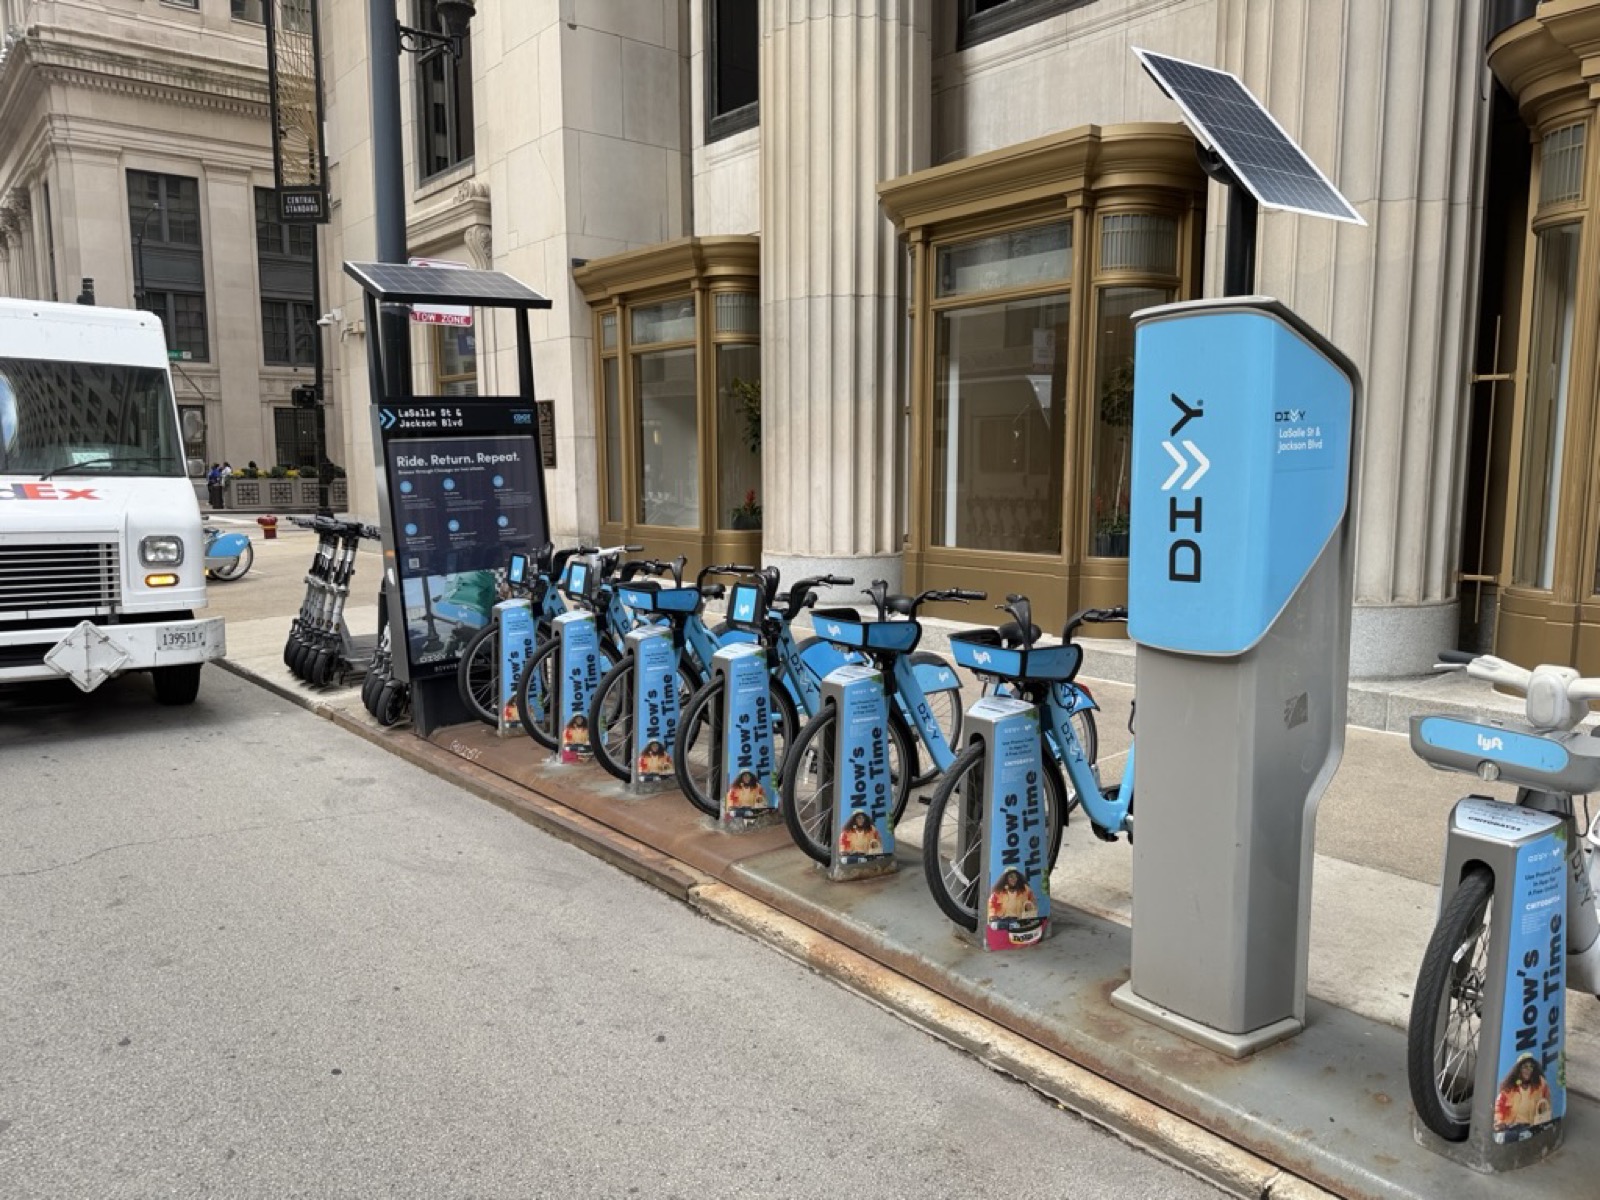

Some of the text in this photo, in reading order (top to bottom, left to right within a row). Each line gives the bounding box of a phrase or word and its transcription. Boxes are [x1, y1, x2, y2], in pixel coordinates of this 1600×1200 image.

[285, 205, 318, 213] STANDARD
[441, 316, 465, 325] ZONE
[397, 408, 462, 417] LaSalle St &
[400, 418, 463, 428] Jackson Blvd
[1279, 426, 1321, 438] LaSalle St &
[396, 451, 520, 467] Ride. Return. Repeat.
[1277, 439, 1323, 453] Jackson Blvd
[163, 632, 197, 646] 139511
[972, 649, 992, 665] lyft
[568, 666, 584, 712] Now's
[584, 654, 598, 692] Time
[643, 688, 660, 738] Now's
[660, 674, 676, 749] The Time
[735, 713, 753, 768] Now's
[753, 696, 771, 781] The Time
[1477, 733, 1504, 751] lyft
[848, 746, 868, 809] Now's
[868, 727, 887, 822] The Time
[1000, 793, 1020, 867] Now's
[1022, 769, 1041, 882] The Time
[1516, 949, 1540, 1052] Now's
[1542, 912, 1562, 1072] The Time
